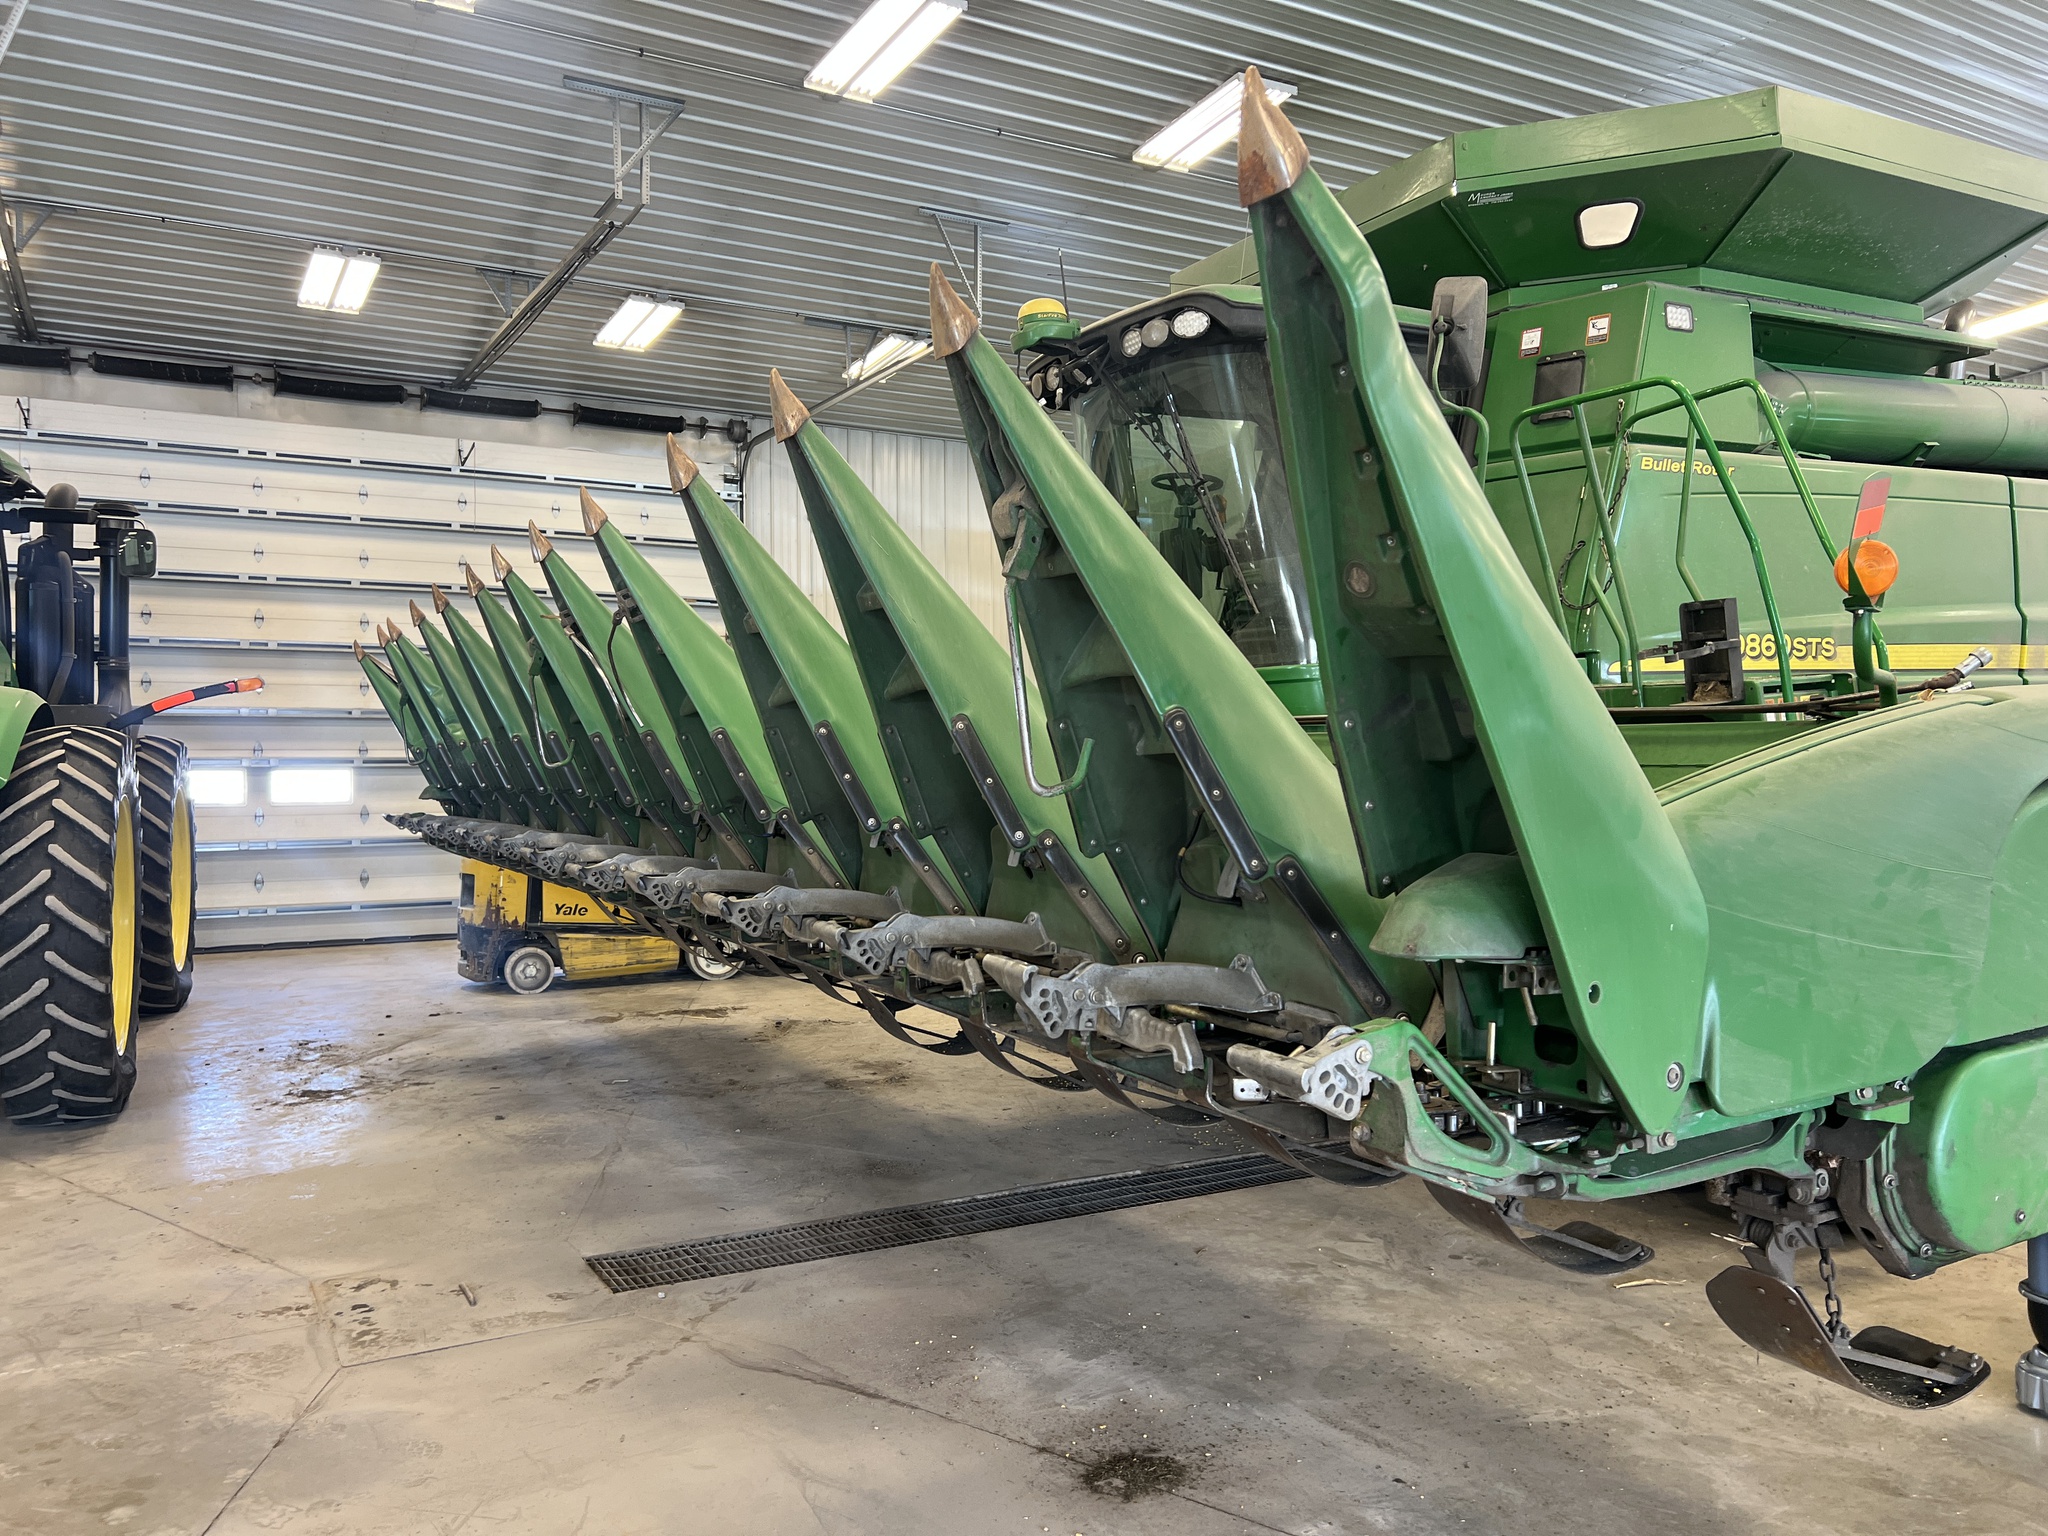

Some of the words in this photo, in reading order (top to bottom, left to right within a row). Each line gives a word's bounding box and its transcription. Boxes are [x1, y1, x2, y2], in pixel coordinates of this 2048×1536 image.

[1641, 456, 1685, 473] Bullet
[1693, 461, 1735, 476] Rotr
[555, 903, 588, 916] Yale
